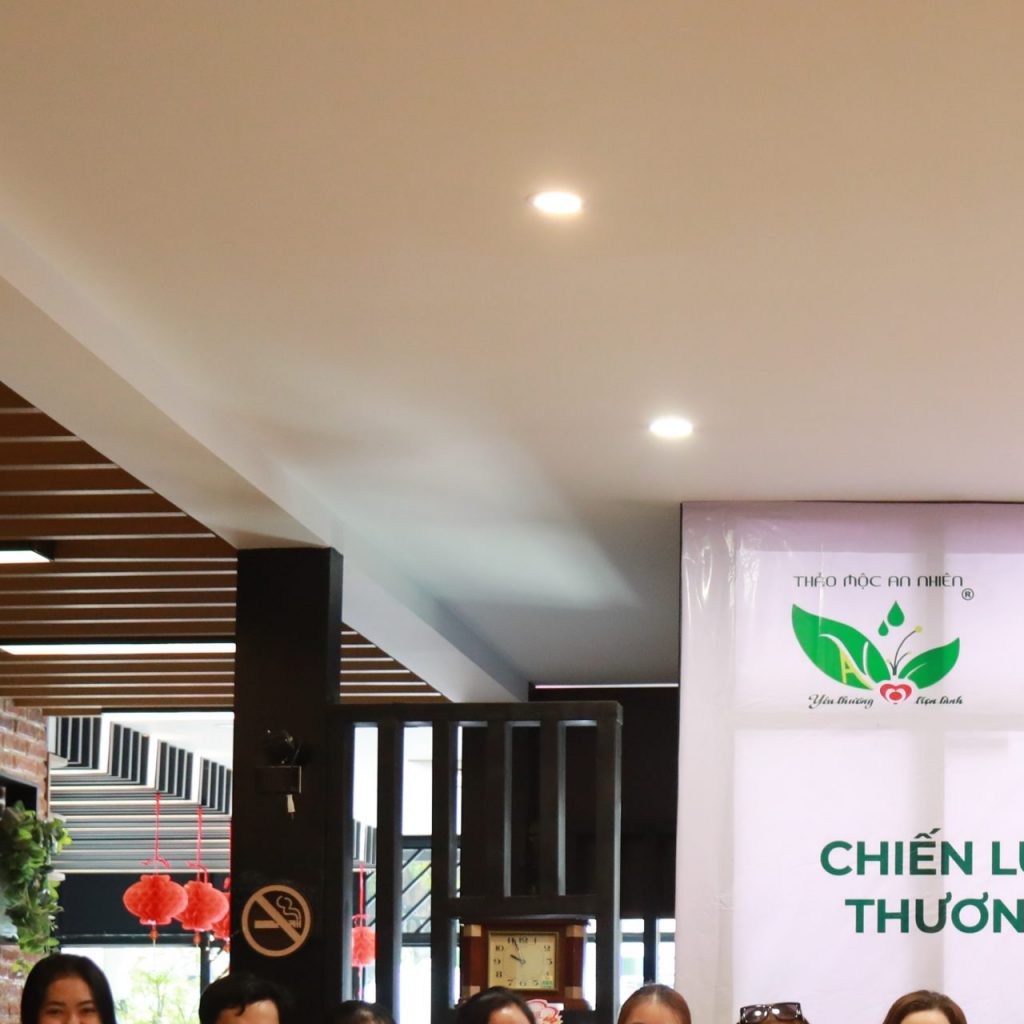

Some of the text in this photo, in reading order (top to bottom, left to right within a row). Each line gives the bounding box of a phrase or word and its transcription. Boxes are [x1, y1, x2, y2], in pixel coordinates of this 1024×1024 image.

[843, 572, 882, 590] MỘC
[888, 576, 911, 587] AN
[917, 572, 963, 587] NHIÊN
[820, 828, 973, 876] CHIẾN
